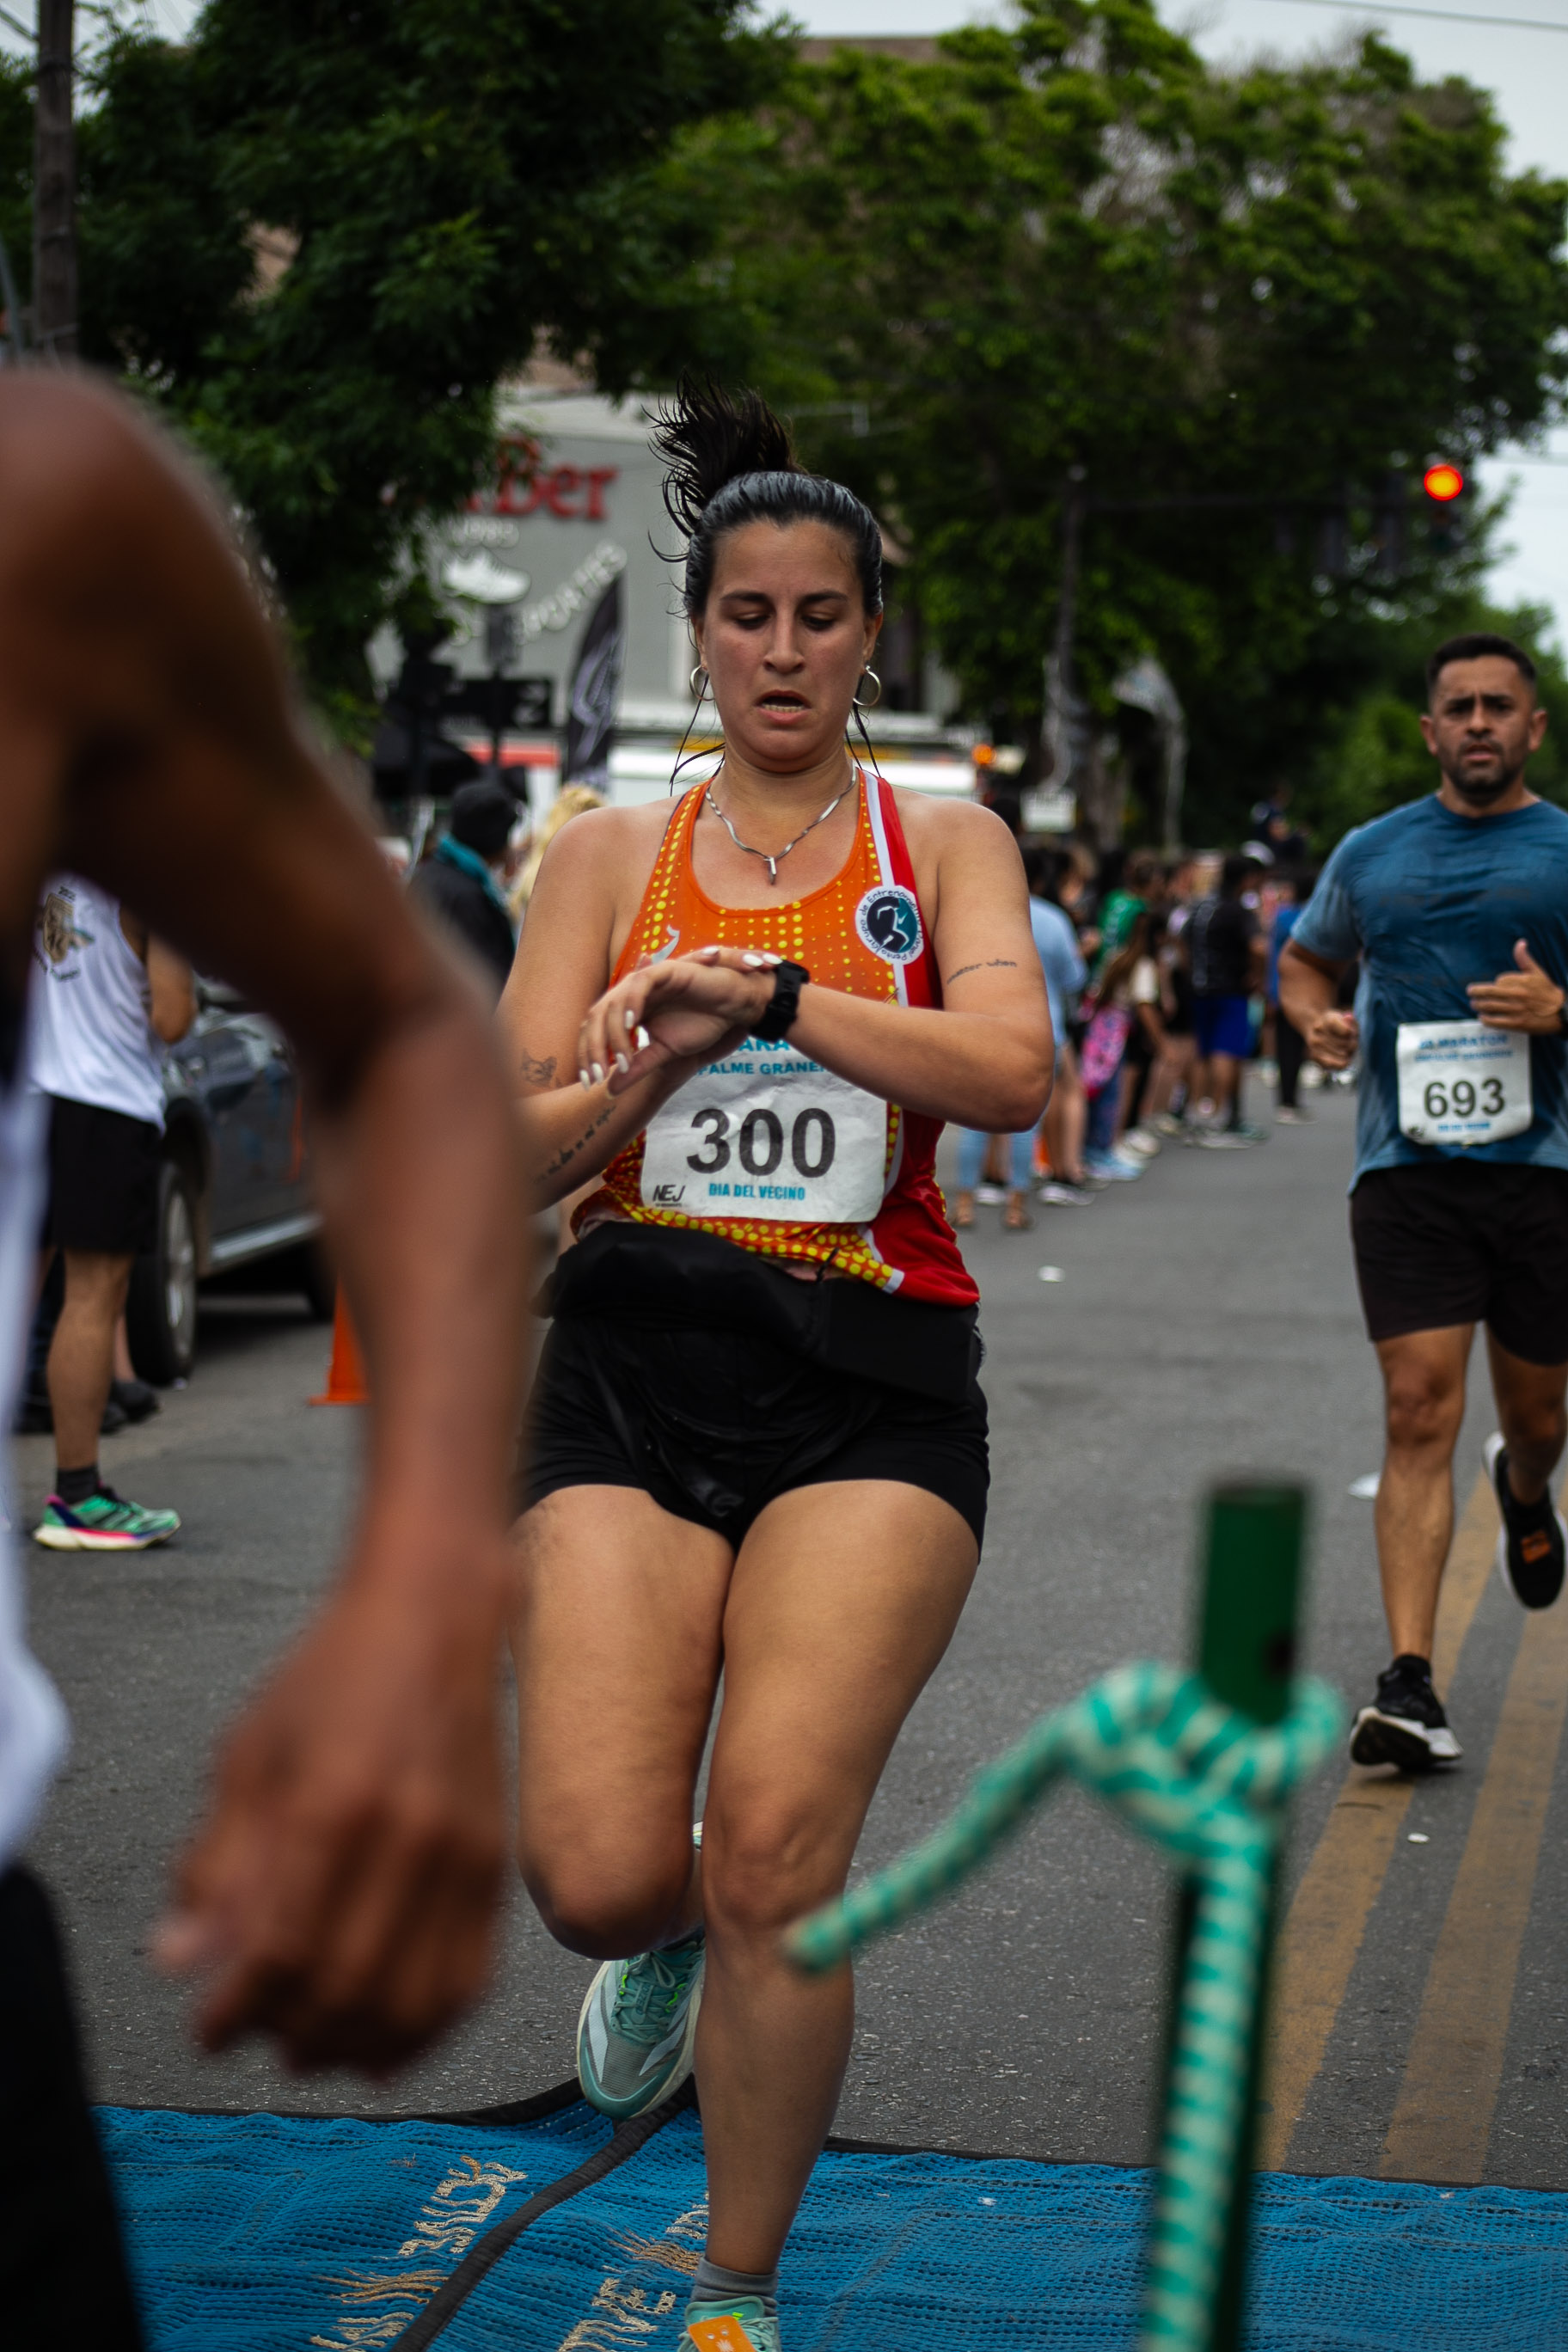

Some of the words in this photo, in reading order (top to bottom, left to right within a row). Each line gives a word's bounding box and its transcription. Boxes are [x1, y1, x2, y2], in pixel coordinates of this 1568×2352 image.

[860, 904, 868, 916] de
[759, 1062, 824, 1075] GRANE
[1424, 1078, 1505, 1118] 693
[686, 1108, 836, 1178] 300
[708, 1183, 730, 1197] DIA
[733, 1185, 755, 1197] DEL
[759, 1185, 805, 1201] VECINO
